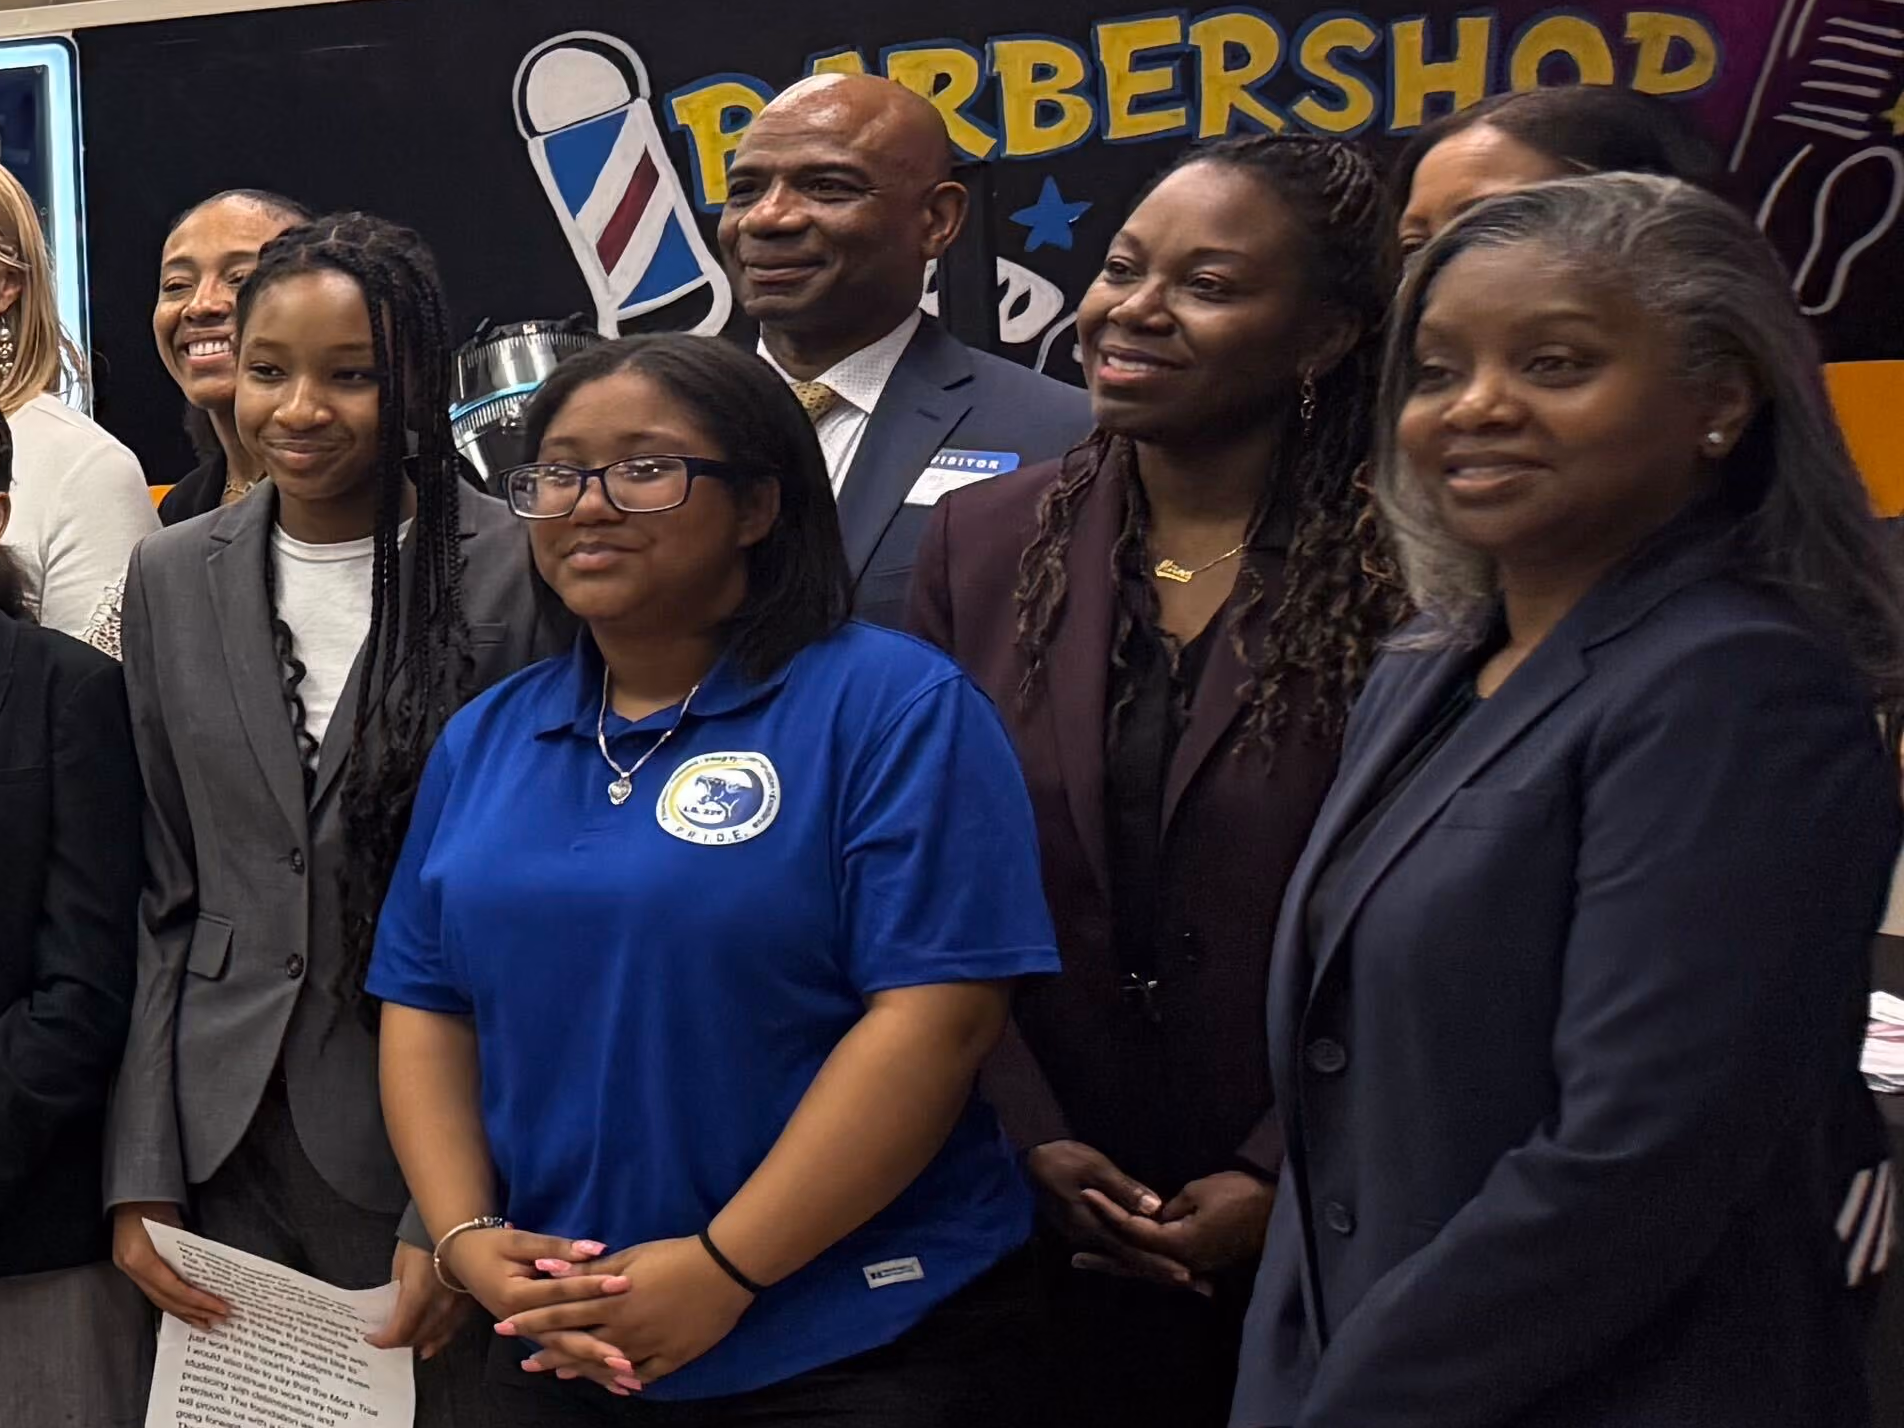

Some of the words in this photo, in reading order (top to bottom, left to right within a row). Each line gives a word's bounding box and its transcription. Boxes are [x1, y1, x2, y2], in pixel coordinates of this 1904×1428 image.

[664, 8, 1722, 214] BRBERSHOP
[187, 1332, 207, 1344] just
[207, 1339, 230, 1352] work
[184, 1359, 226, 1376] students
[268, 1384, 279, 1395] to
[280, 1389, 303, 1402] work
[304, 1399, 325, 1412] very
[192, 1349, 221, 1362] would
[243, 1363, 261, 1375] like
[261, 1369, 273, 1380] to
[312, 1387, 329, 1400] the
[329, 1393, 356, 1409] Mock
[358, 1403, 379, 1417] Trial
